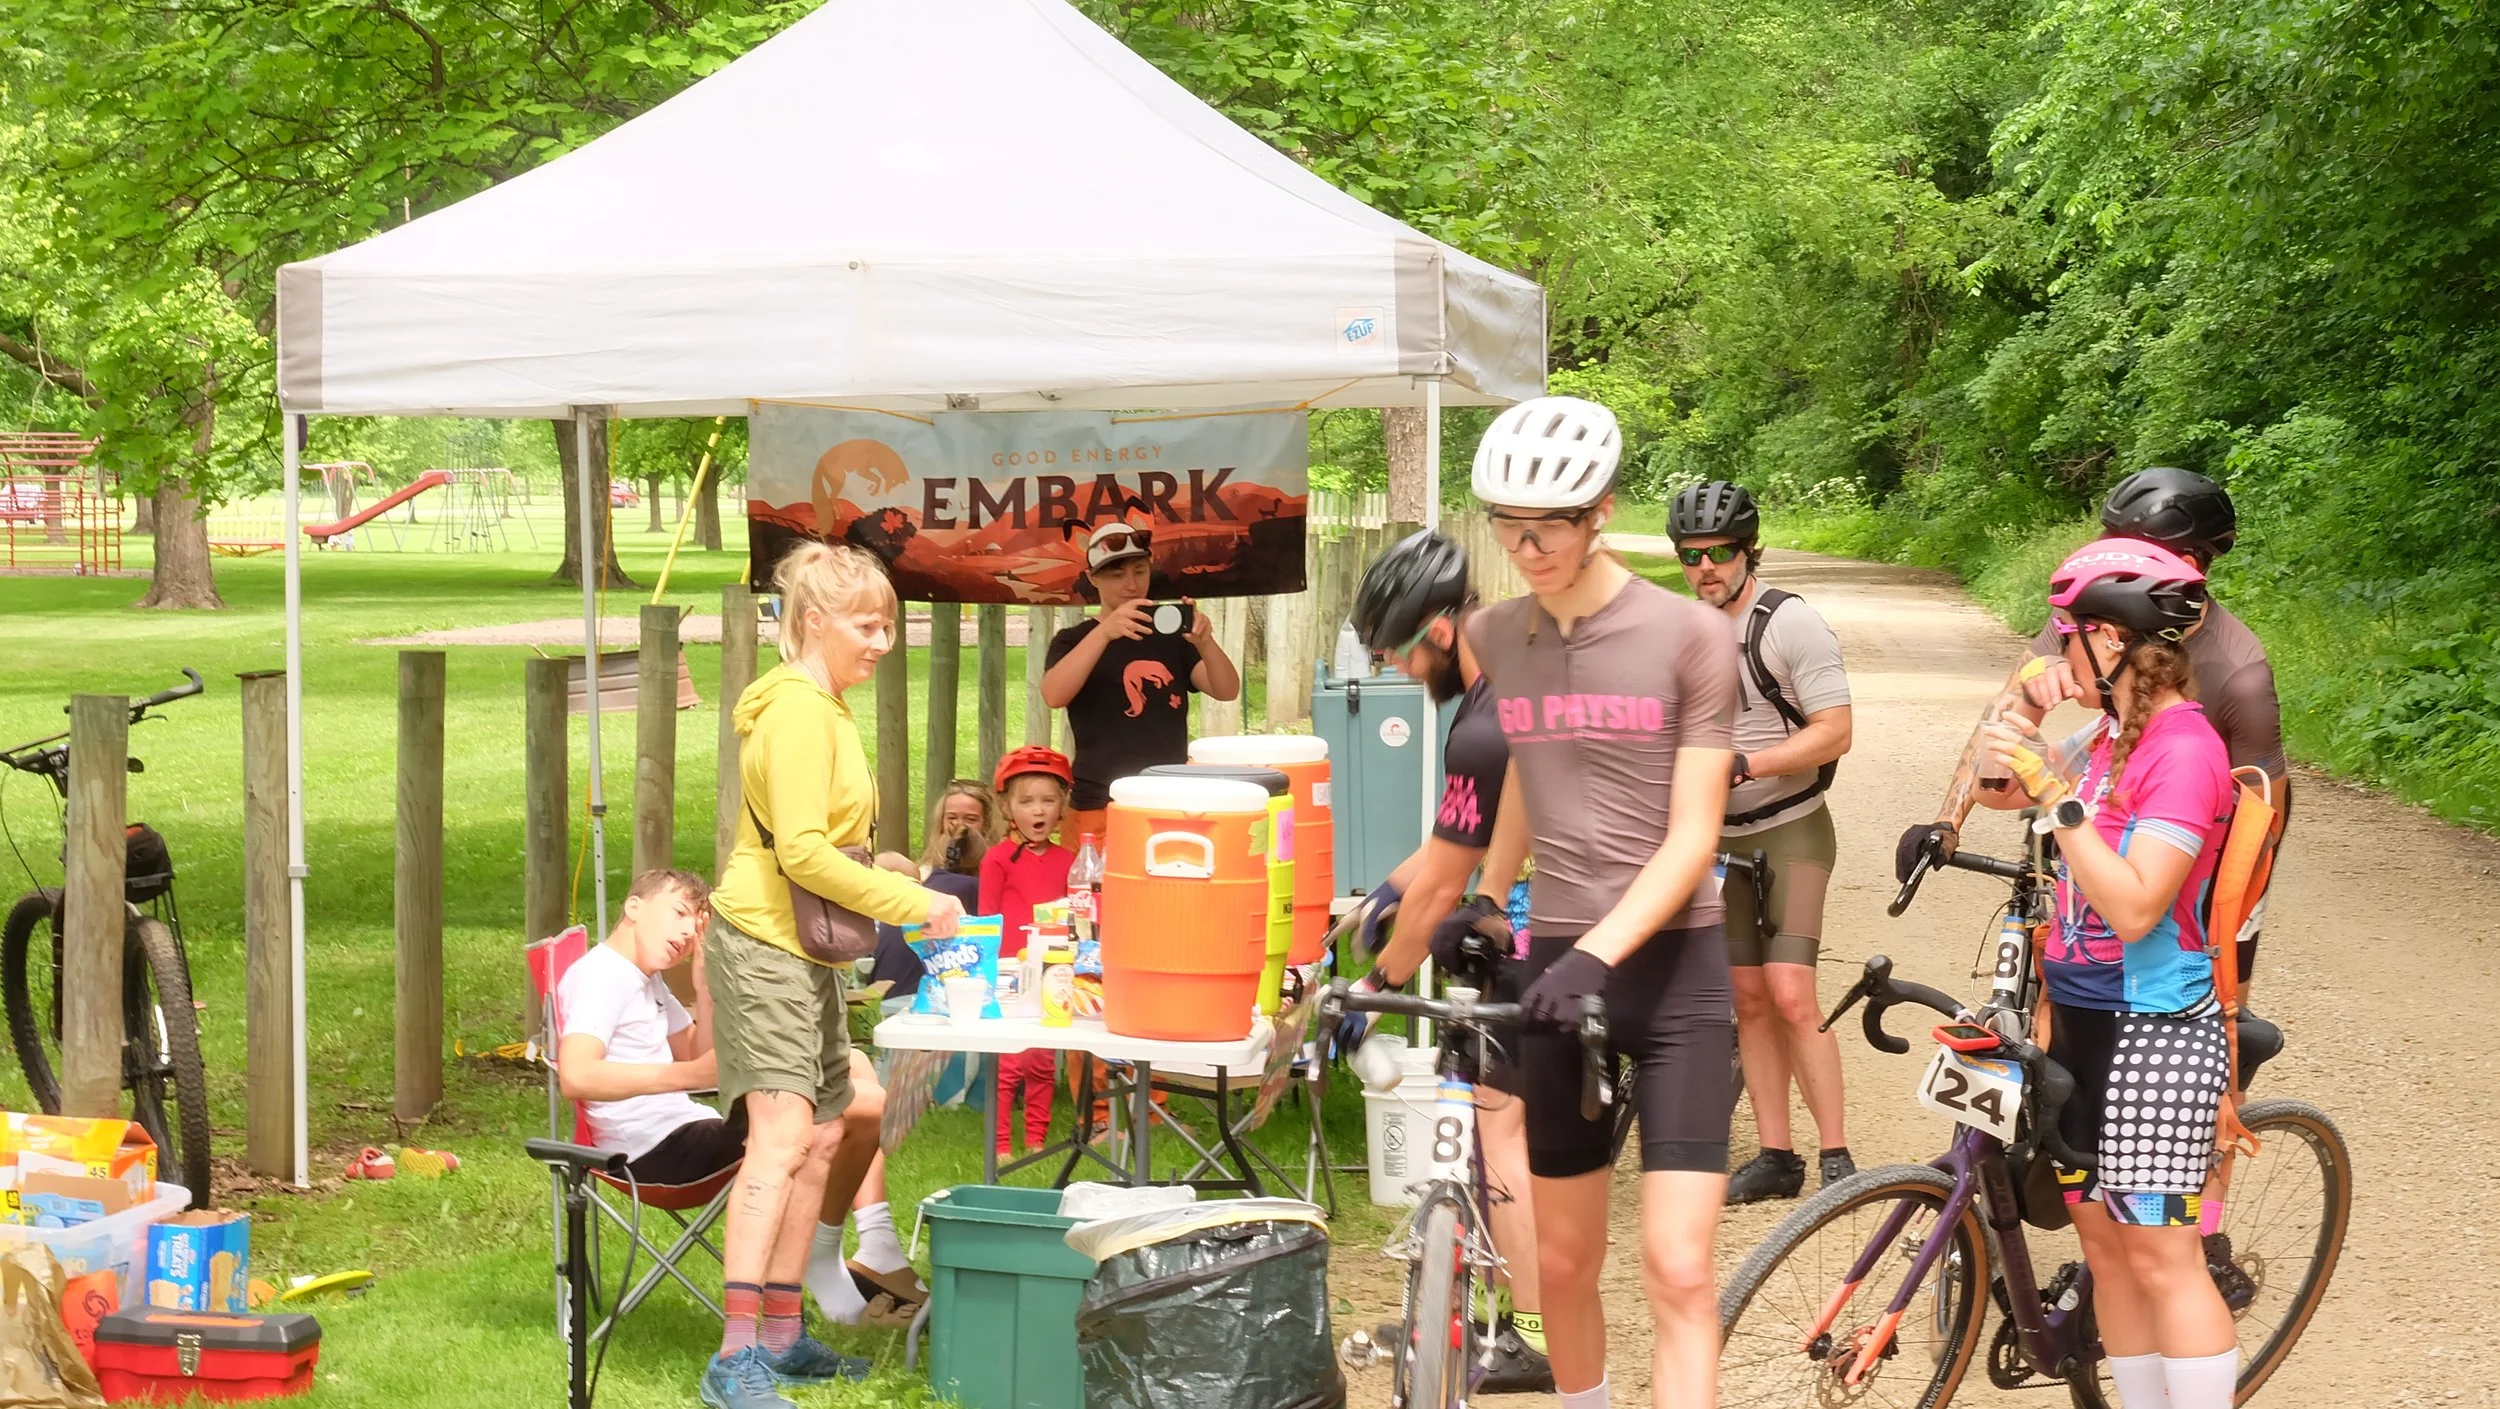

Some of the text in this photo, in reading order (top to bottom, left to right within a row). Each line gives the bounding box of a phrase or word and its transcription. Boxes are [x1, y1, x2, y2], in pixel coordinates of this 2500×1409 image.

[992, 445, 1163, 467] GOOD ENERGY
[922, 466, 1240, 530] EMBARK
[2063, 551, 2151, 571] RUDY
[1497, 693, 1665, 734] GO PHYSIO
[1994, 941, 2020, 979] 8
[1926, 1052, 2006, 1127] 124
[1433, 1116, 1463, 1163] 8
